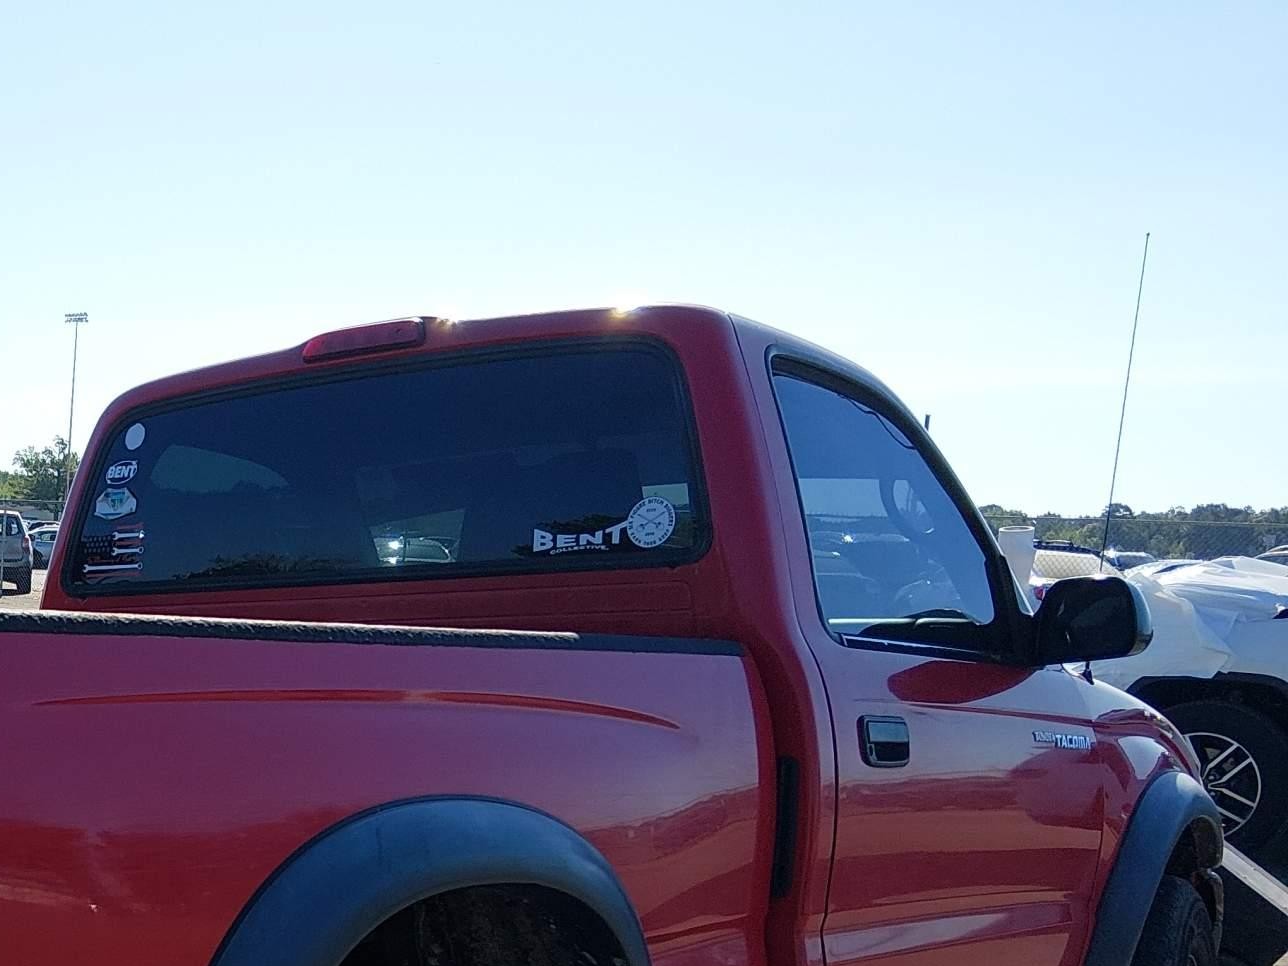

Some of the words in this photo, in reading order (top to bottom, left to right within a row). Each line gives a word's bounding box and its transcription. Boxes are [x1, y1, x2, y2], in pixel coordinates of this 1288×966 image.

[107, 463, 137, 479] BENT
[533, 520, 629, 552] BENT
[1056, 734, 1091, 749] TACOMA
